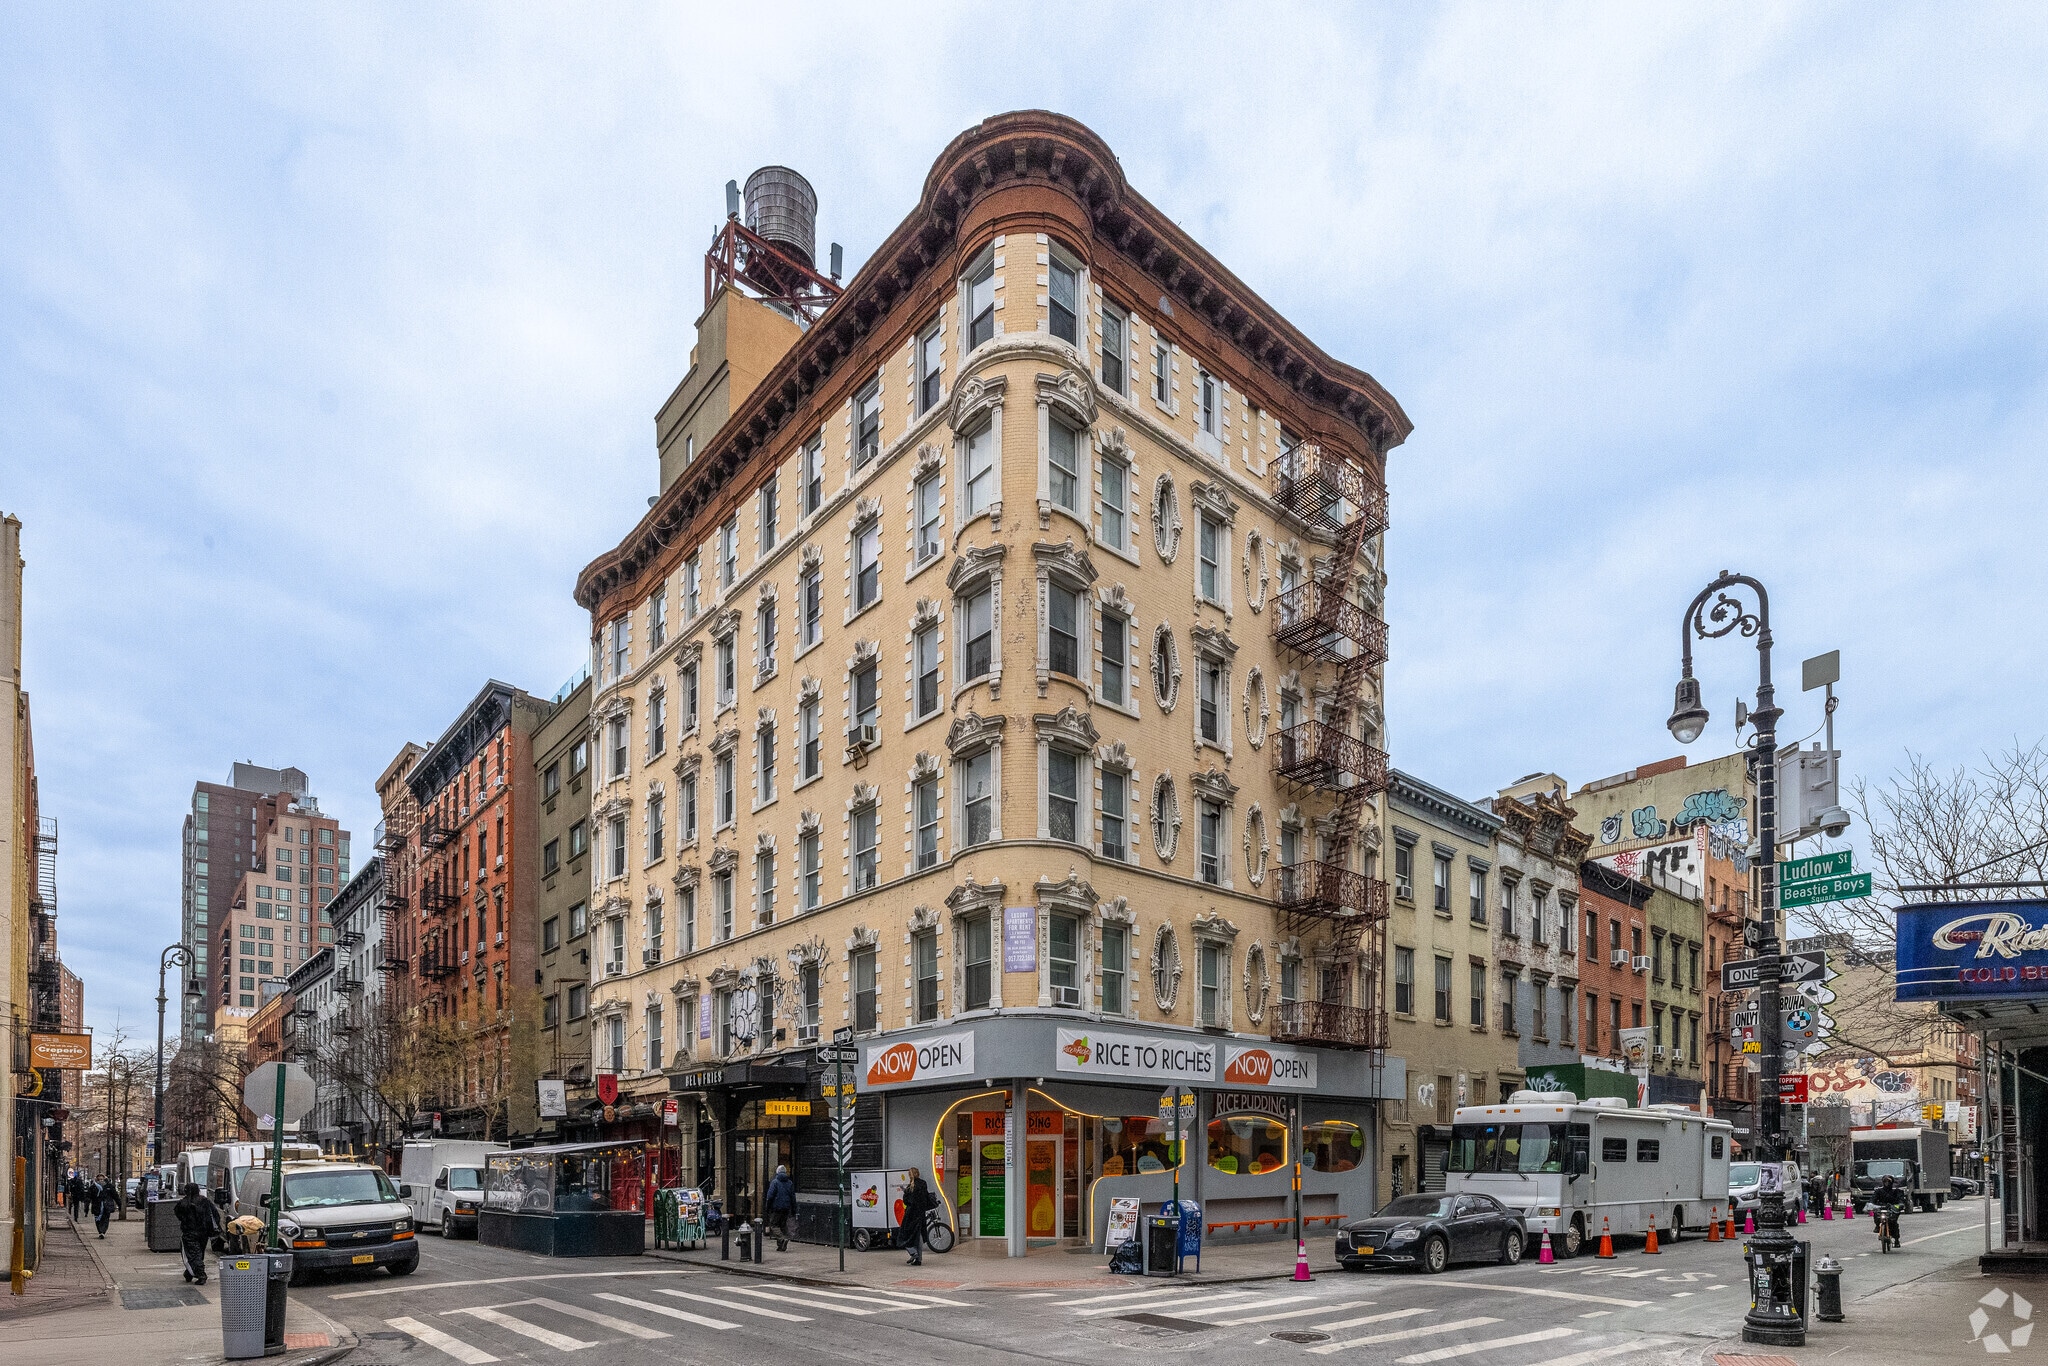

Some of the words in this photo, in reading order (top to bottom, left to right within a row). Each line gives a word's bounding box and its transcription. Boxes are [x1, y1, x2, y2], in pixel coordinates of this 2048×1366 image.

[1783, 861, 1833, 881] Ludlow
[1838, 853, 1848, 864] St
[1784, 883, 1828, 900] Beastie
[1834, 879, 1865, 892] Boys
[1811, 894, 1836, 903] Square
[1732, 969, 1759, 981] ONE
[1779, 961, 1807, 975] WAY
[1959, 966, 2018, 983] COLD
[2021, 965, 2048, 979] BE
[38, 1046, 83, 1054] Creperie
[822, 1051, 836, 1059] ONE
[877, 1050, 914, 1076] NOW
[918, 1042, 962, 1070] OPEN
[1095, 1042, 1130, 1067] RICE
[1134, 1045, 1158, 1069] TO
[1162, 1048, 1212, 1073] RICHES
[1234, 1054, 1269, 1076] NOW
[1273, 1058, 1308, 1079] OPEN
[685, 1074, 697, 1087] BEL
[702, 1070, 722, 1085] FRIES
[1216, 1093, 1239, 1112] RICE
[1241, 1093, 1287, 1117] PUDDING
[985, 1117, 1005, 1129] RICE
